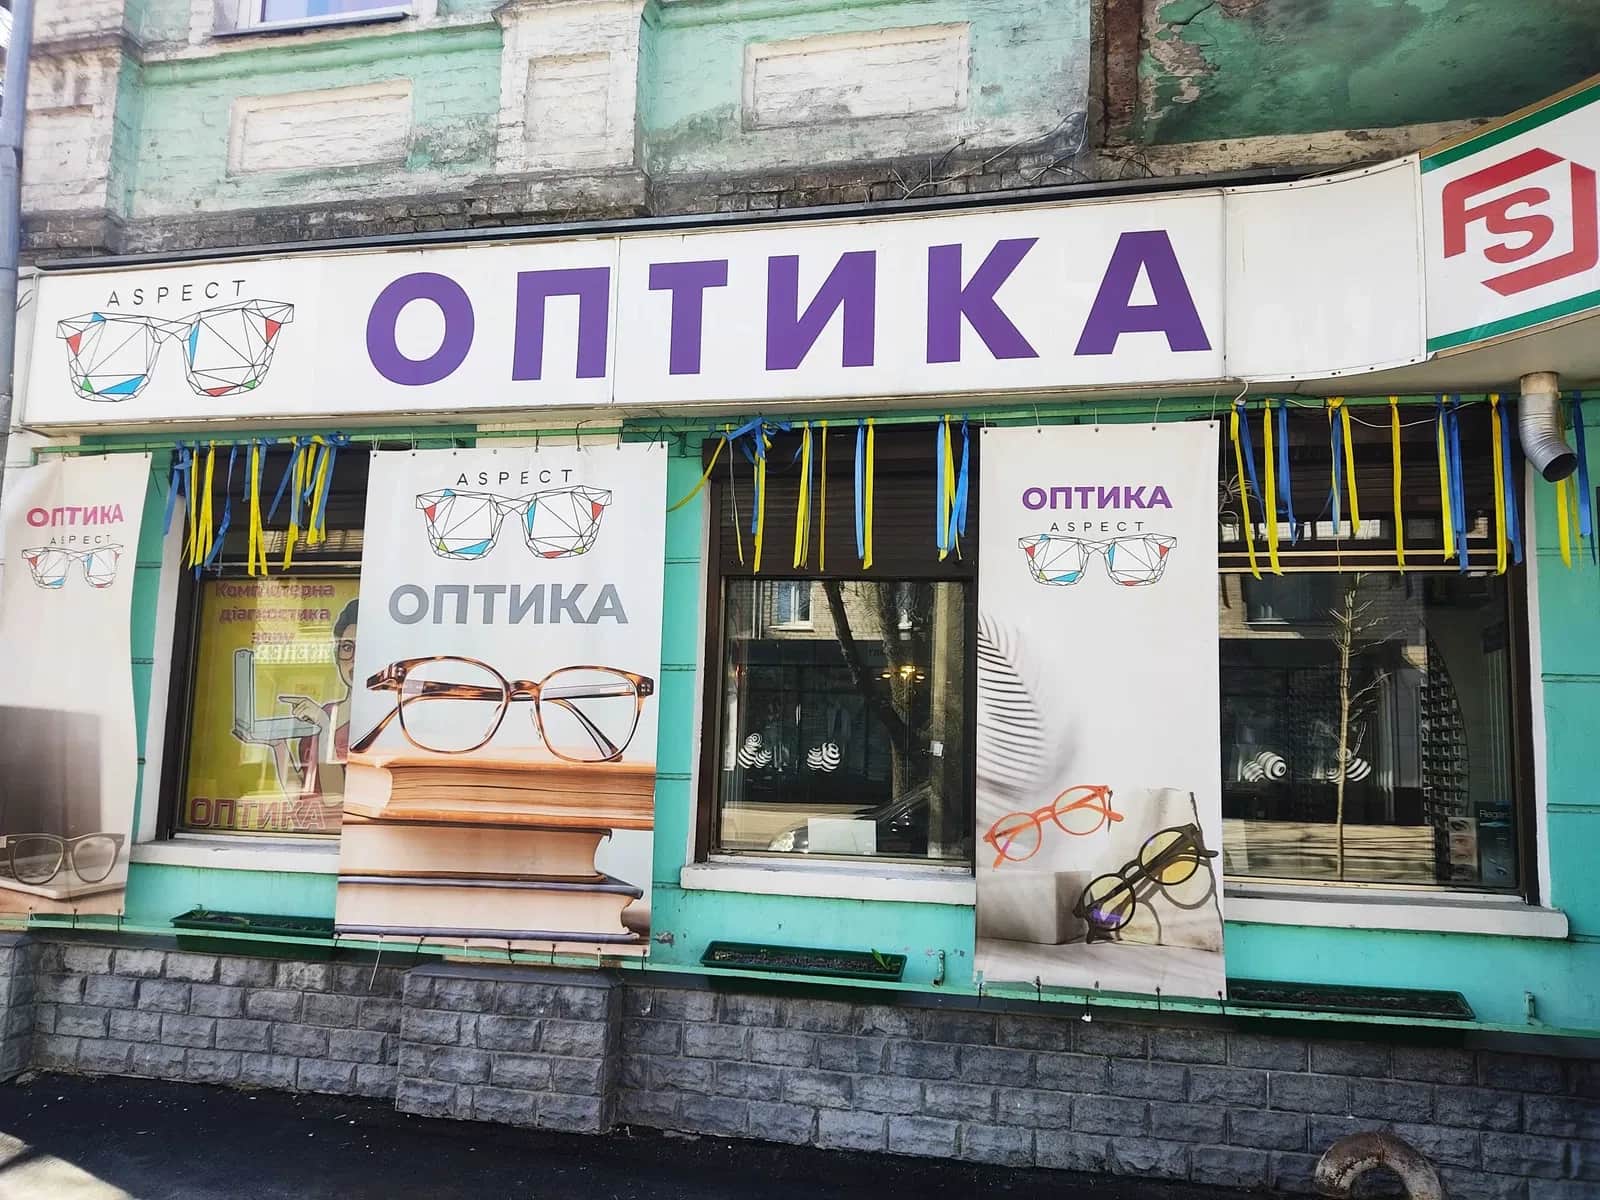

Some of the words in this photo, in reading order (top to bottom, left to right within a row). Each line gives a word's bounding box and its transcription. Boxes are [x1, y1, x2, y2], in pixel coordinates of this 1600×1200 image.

[107, 278, 247, 306] ASPECT
[366, 230, 1212, 386] ОПТИКА
[456, 469, 575, 486] ASPECT
[1022, 486, 1173, 510] ОПТИКА
[26, 504, 124, 528] ОПТИКА
[1049, 521, 1145, 533] ASPECT
[49, 534, 111, 545] ASPECT
[389, 584, 628, 624] ОПТИКА
[189, 796, 326, 830] ОПТИКА
